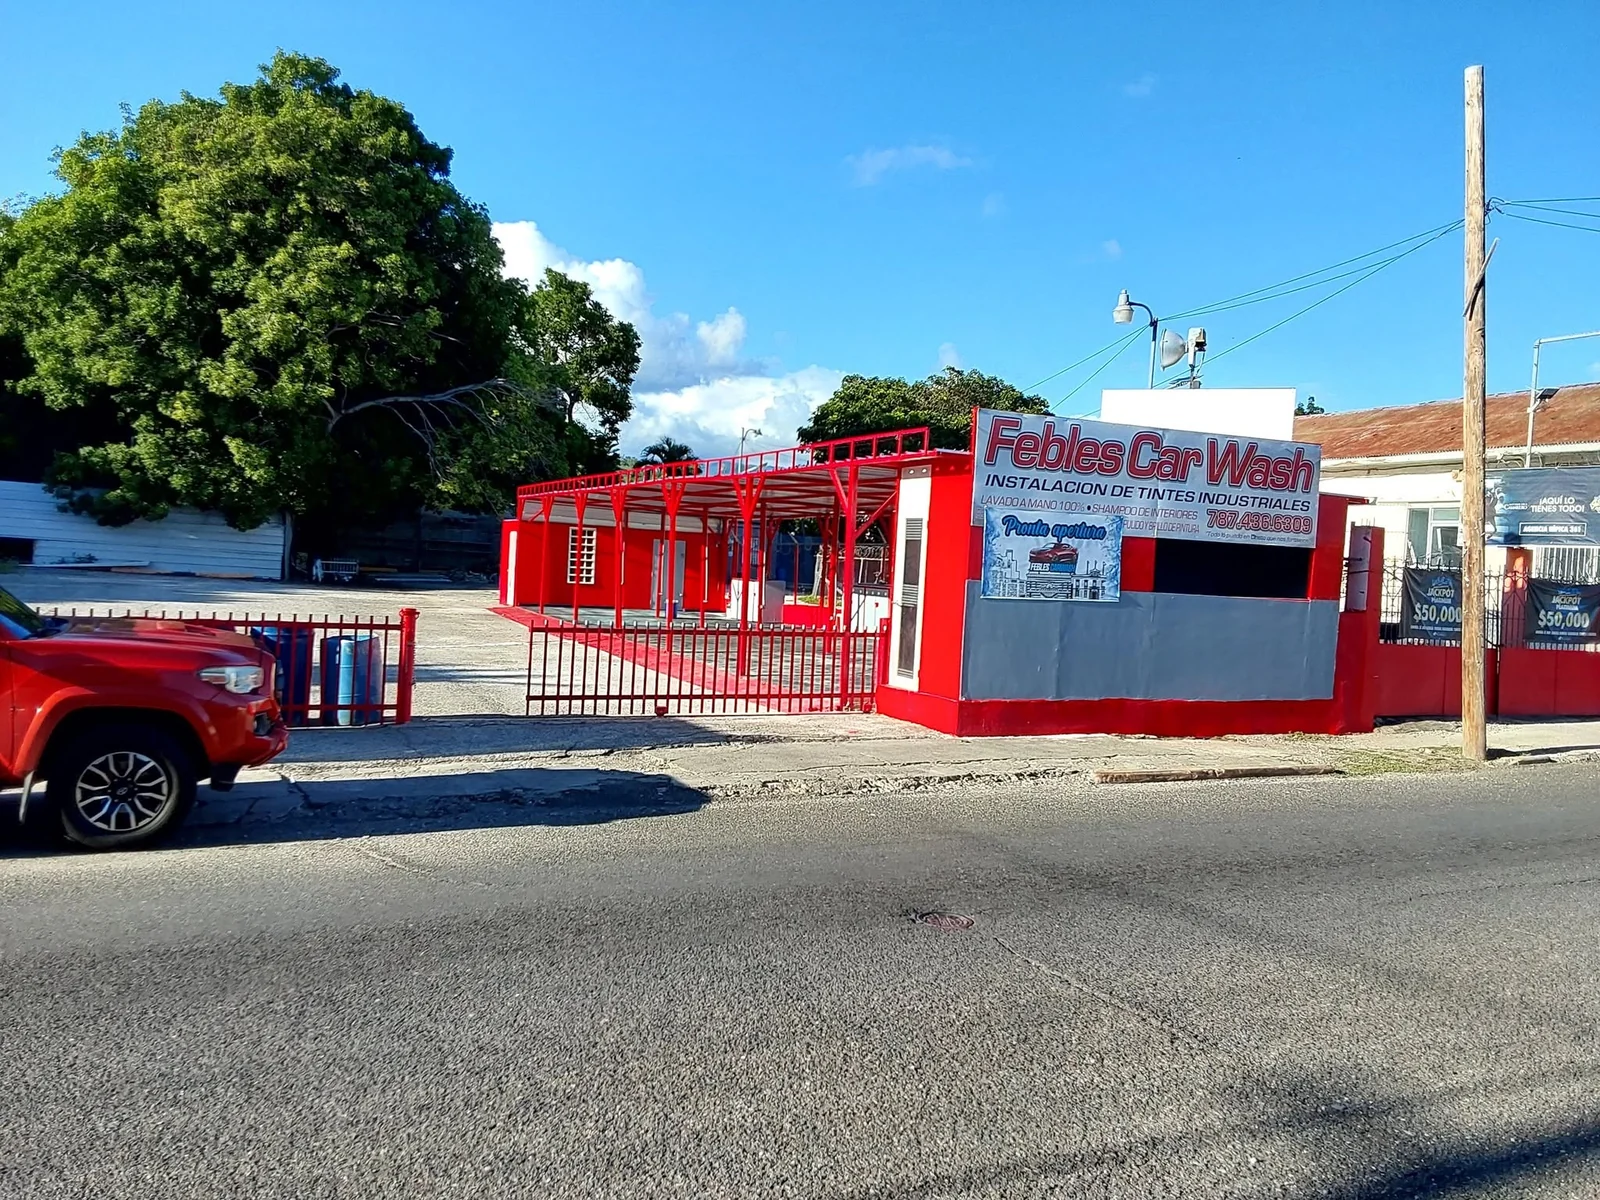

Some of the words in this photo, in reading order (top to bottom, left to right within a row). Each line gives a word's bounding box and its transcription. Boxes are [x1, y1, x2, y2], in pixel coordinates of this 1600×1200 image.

[984, 414, 1126, 476] Febles
[1127, 431, 1203, 481] Car
[1206, 438, 1314, 493] Wash
[985, 474, 1107, 496] INSTALACION
[1110, 485, 1134, 498] DE
[1138, 487, 1196, 503] TINTES
[1198, 492, 1311, 512] INDUSTRIALES
[981, 495, 1019, 506] LAVADO
[1020, 498, 1026, 507] A
[1027, 498, 1057, 510] MANO
[1059, 501, 1085, 511] 100%
[1091, 503, 1137, 515] SHAMPOO
[1138, 507, 1150, 517] DE
[1151, 508, 1199, 520] INTERIORES
[1530, 504, 1557, 513] TIENES
[1002, 515, 1050, 537] Pronta
[1051, 521, 1107, 543] apertura
[1206, 508, 1313, 535] 787.436.6309
[1426, 587, 1455, 598] JACKPOT
[1551, 595, 1582, 605] JACKPOT
[1413, 602, 1462, 624] $50,000
[1538, 609, 1590, 630] $50,000
